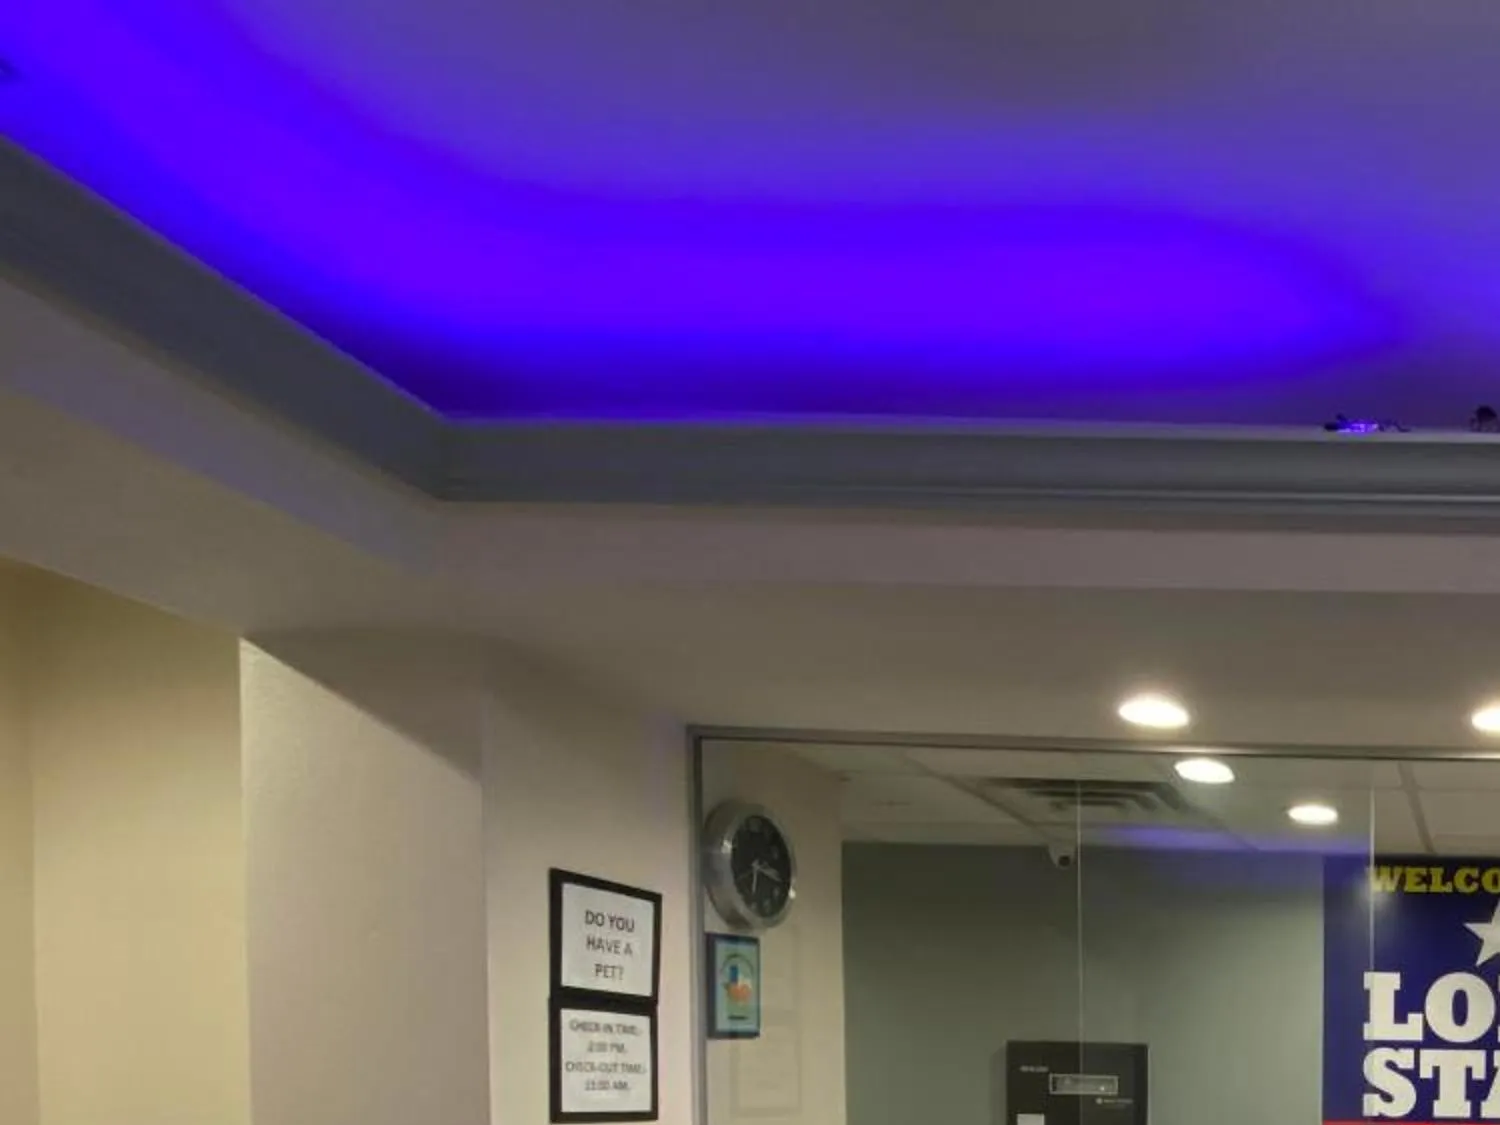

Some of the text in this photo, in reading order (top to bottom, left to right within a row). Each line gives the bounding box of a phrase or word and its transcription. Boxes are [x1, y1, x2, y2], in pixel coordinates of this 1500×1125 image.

[585, 908, 635, 933] DO YOU
[586, 934, 634, 957] HAVE A
[594, 962, 625, 981] PET?
